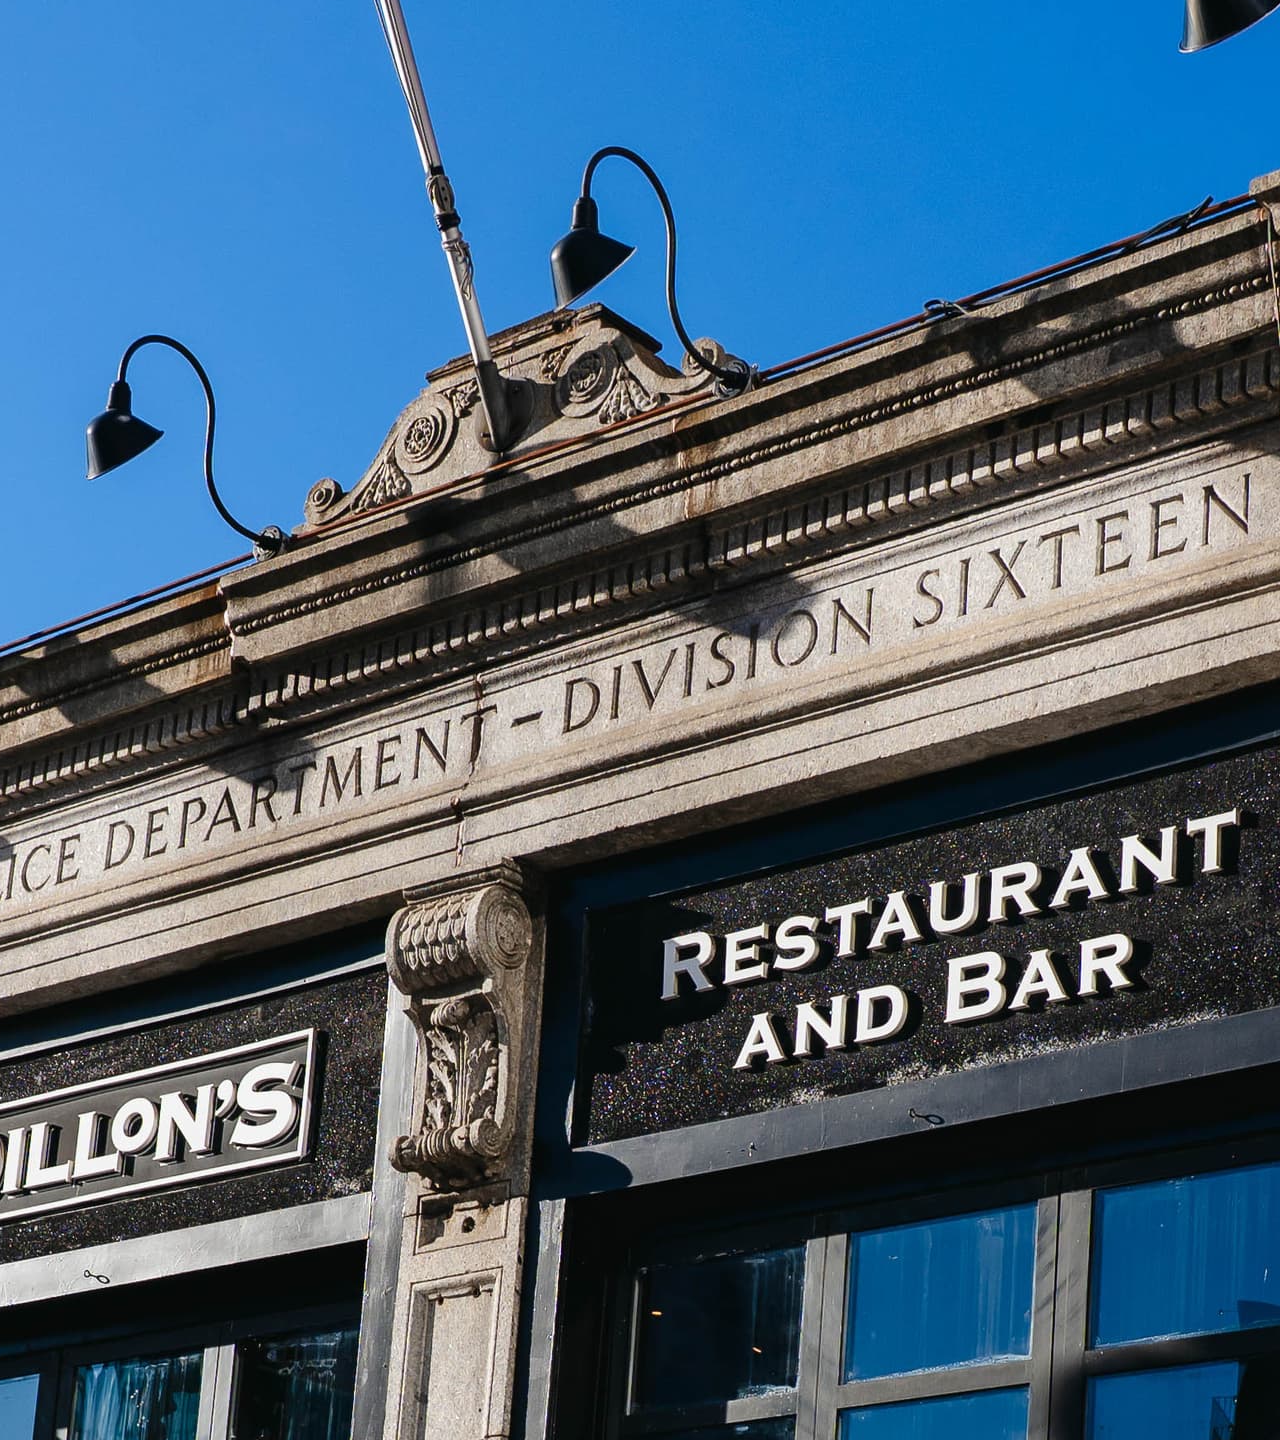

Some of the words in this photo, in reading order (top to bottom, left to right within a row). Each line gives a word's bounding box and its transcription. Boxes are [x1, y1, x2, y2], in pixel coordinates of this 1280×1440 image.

[912, 473, 1252, 630] SIXTEEN
[661, 808, 1241, 1001] RESTAURANT
[732, 984, 909, 1071] AND
[944, 933, 1135, 1026] BAR
